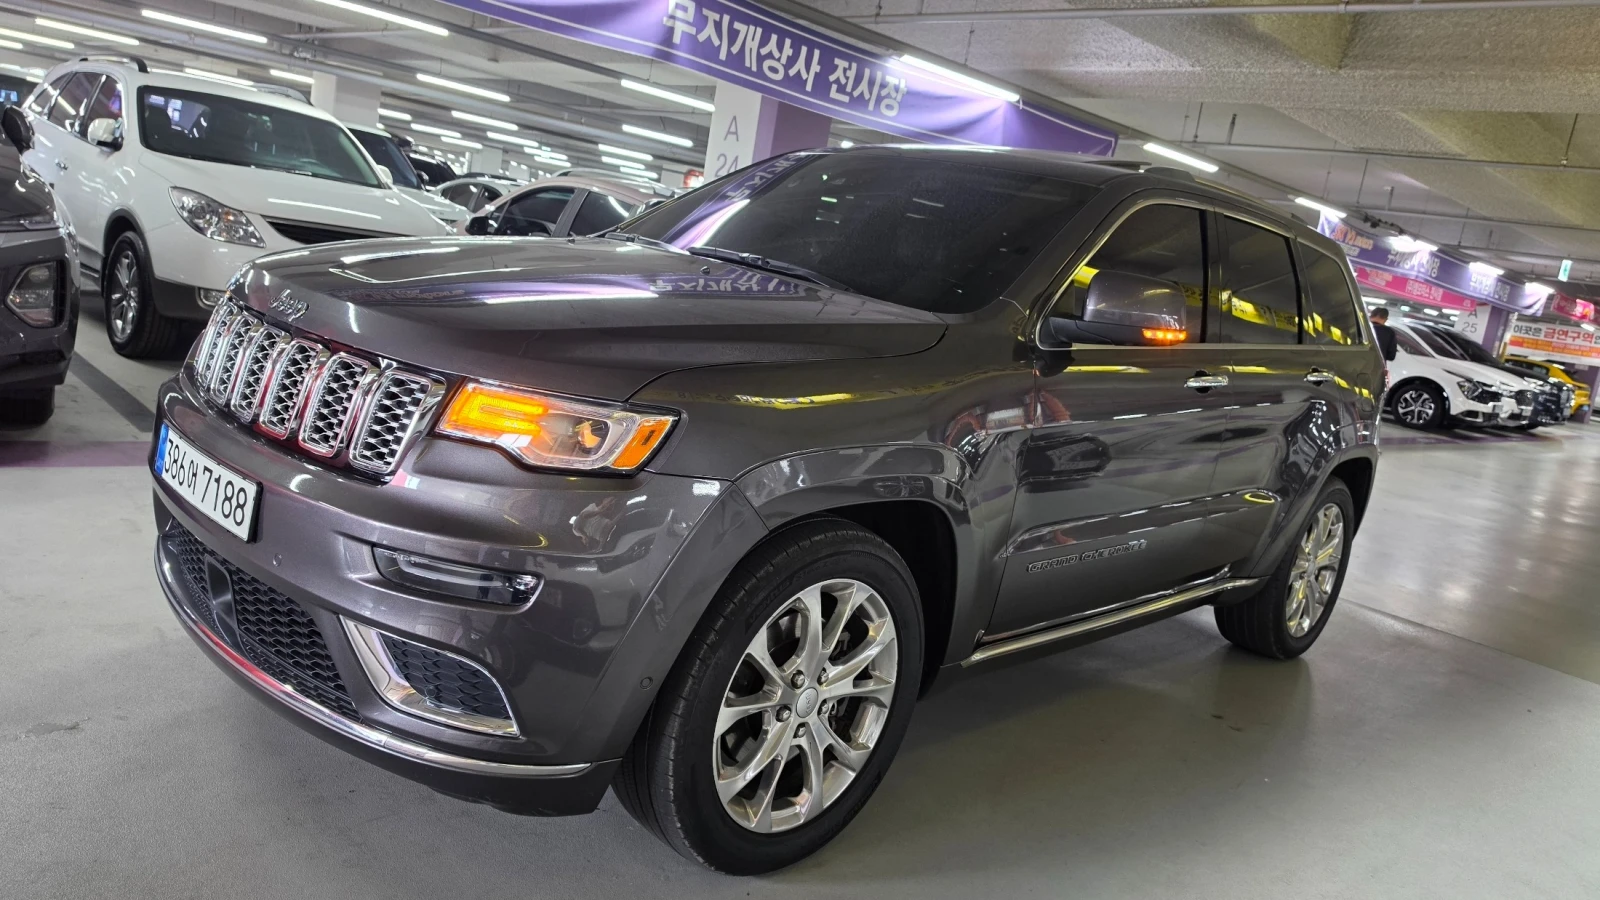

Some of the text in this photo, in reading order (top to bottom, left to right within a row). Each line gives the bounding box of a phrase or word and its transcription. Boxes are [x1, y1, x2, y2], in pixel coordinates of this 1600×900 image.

[663, 0, 907, 118] 무지개상사 전시장
[723, 115, 740, 142] A
[268, 288, 310, 322] Jeep
[1461, 321, 1479, 334] 25
[1513, 324, 1542, 338] 이곳은
[164, 438, 248, 527] 386어 7188
[1026, 538, 1148, 573] GRAND CHEROKEE
